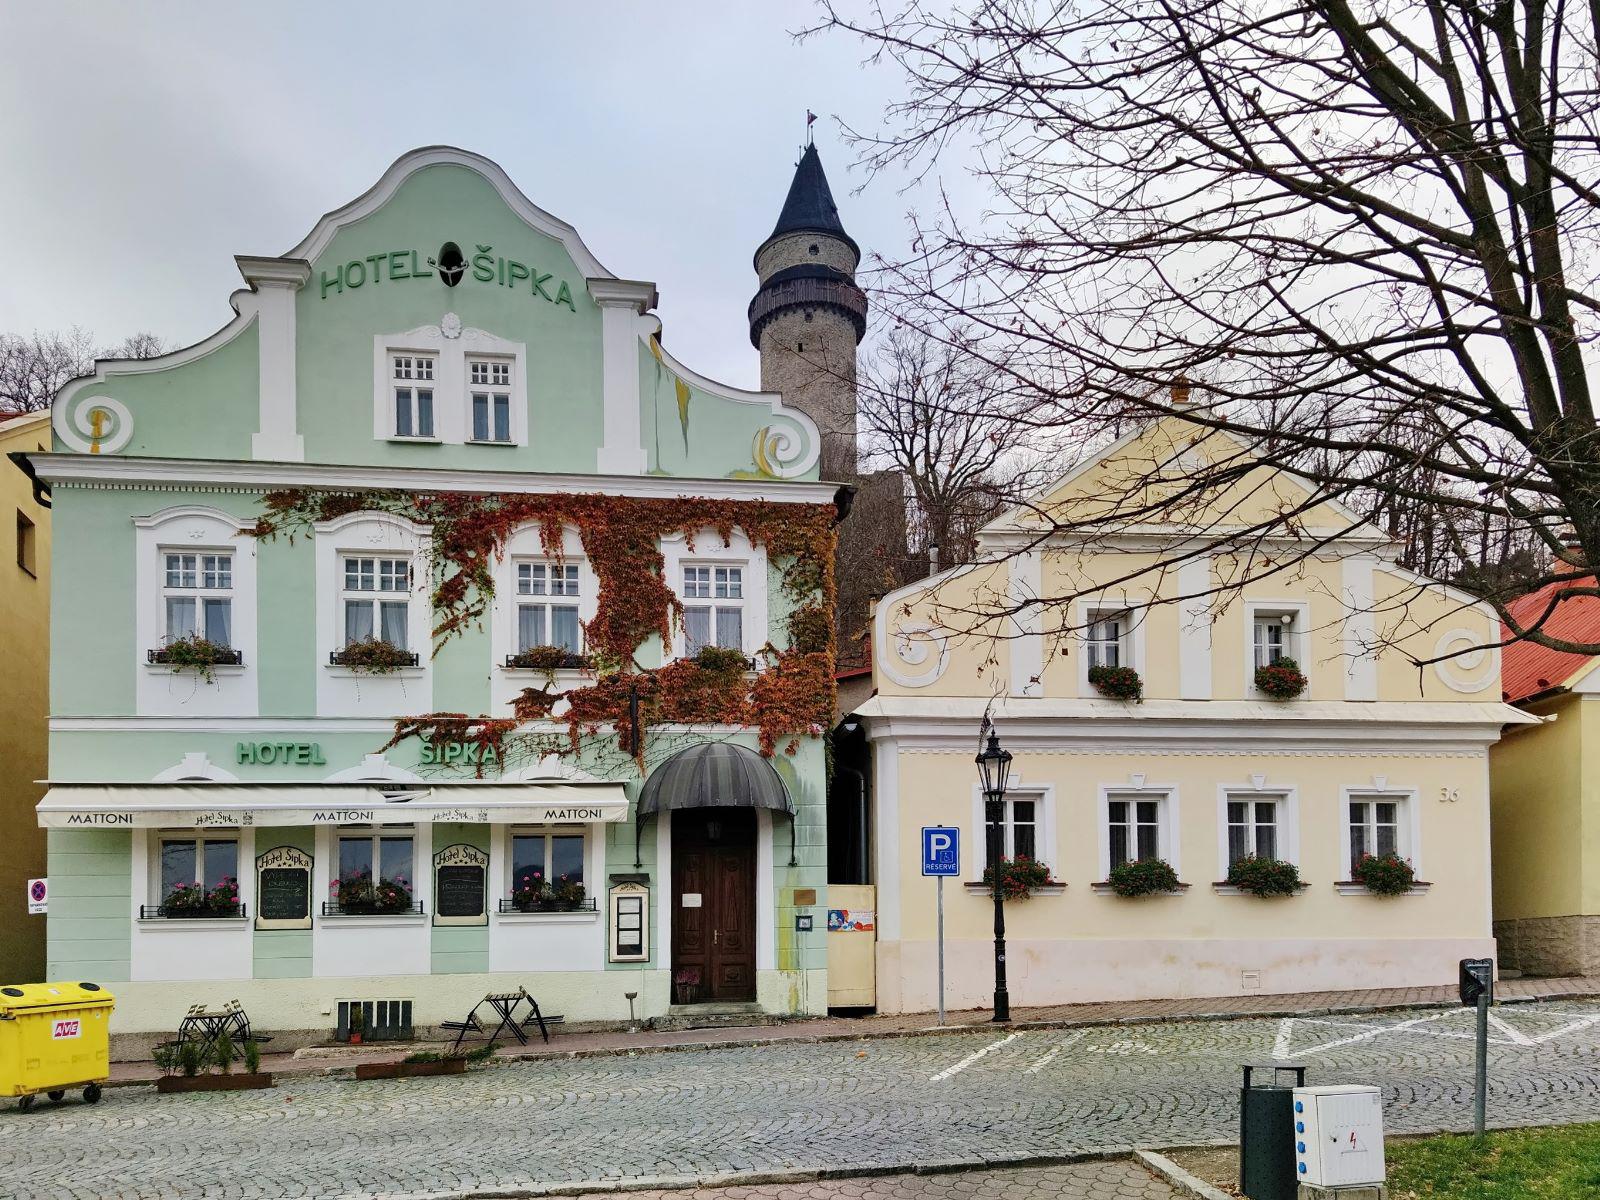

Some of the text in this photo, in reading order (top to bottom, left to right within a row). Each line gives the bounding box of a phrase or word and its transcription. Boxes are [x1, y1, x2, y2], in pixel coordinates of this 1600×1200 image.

[321, 244, 576, 312] HOTEL ŠIPKA
[236, 734, 499, 765] HOTEL ŠIPKA
[1439, 787, 1459, 803] 36
[67, 813, 133, 824] MATTONI
[312, 811, 374, 822] MATTONI
[544, 809, 602, 819] MATTONI
[931, 834, 951, 860] P
[259, 850, 283, 868] Hotel
[437, 848, 460, 865] Hotel
[55, 1021, 79, 1037] AVE
